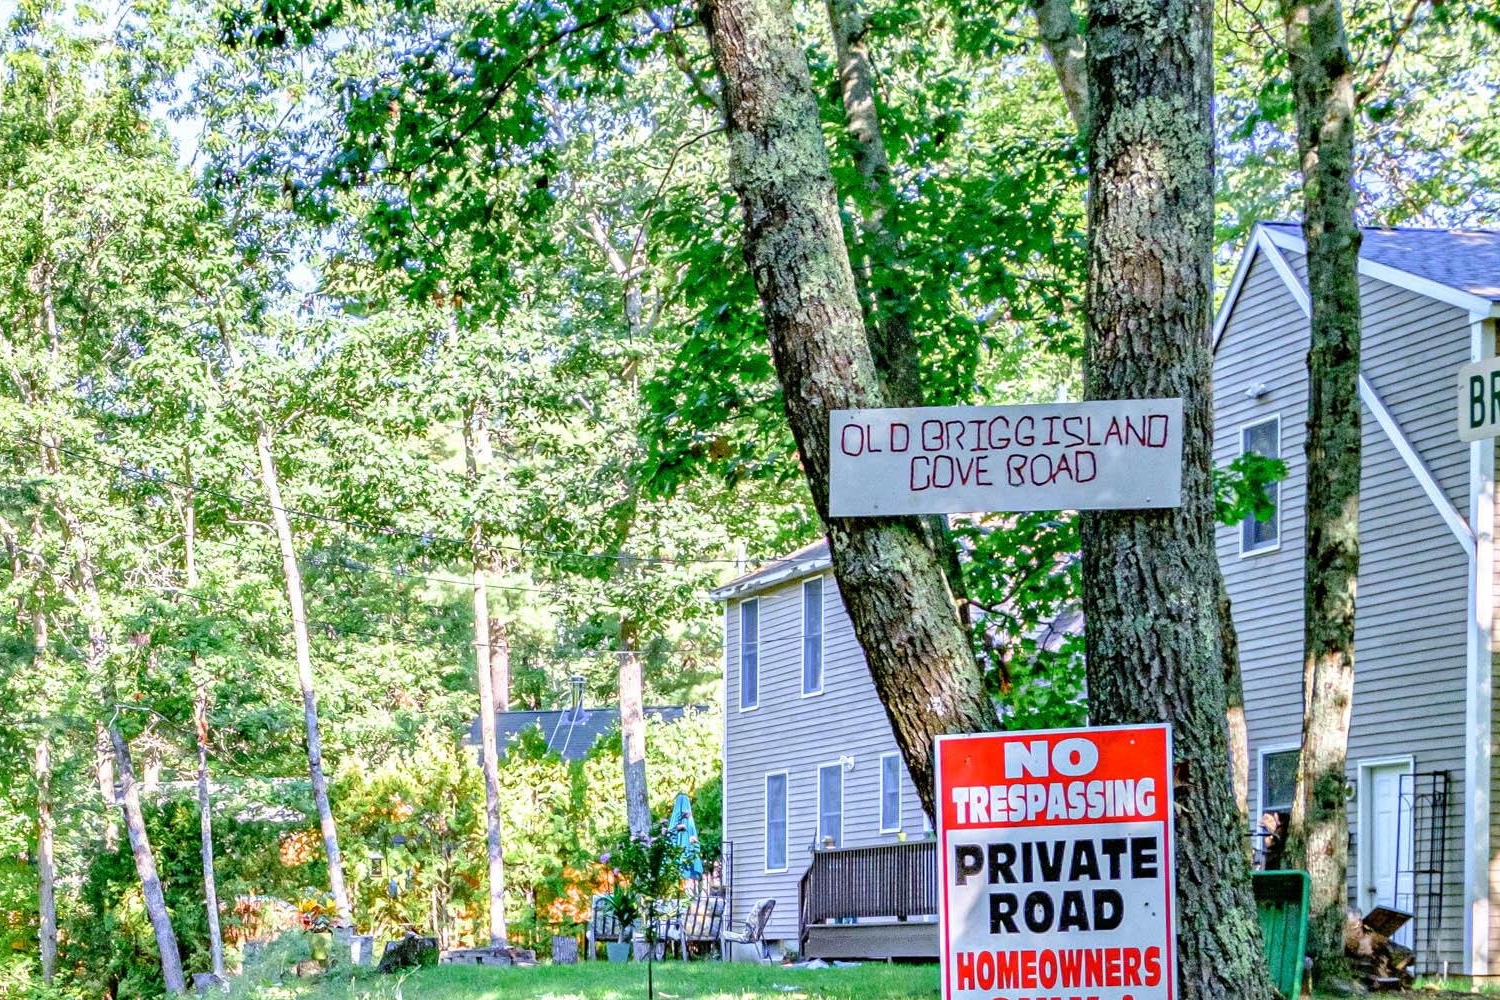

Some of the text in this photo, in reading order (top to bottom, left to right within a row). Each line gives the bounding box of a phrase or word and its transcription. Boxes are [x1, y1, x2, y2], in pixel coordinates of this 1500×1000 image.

[841, 422, 910, 457] OLD
[910, 450, 1098, 492] COVE ROAD
[1004, 737, 1100, 779] NO
[951, 777, 1156, 825] TRESPASSING
[955, 836, 1159, 886] PRIVATE
[989, 888, 1125, 935] ROAD
[956, 946, 1162, 991] HOMEOWNERS
